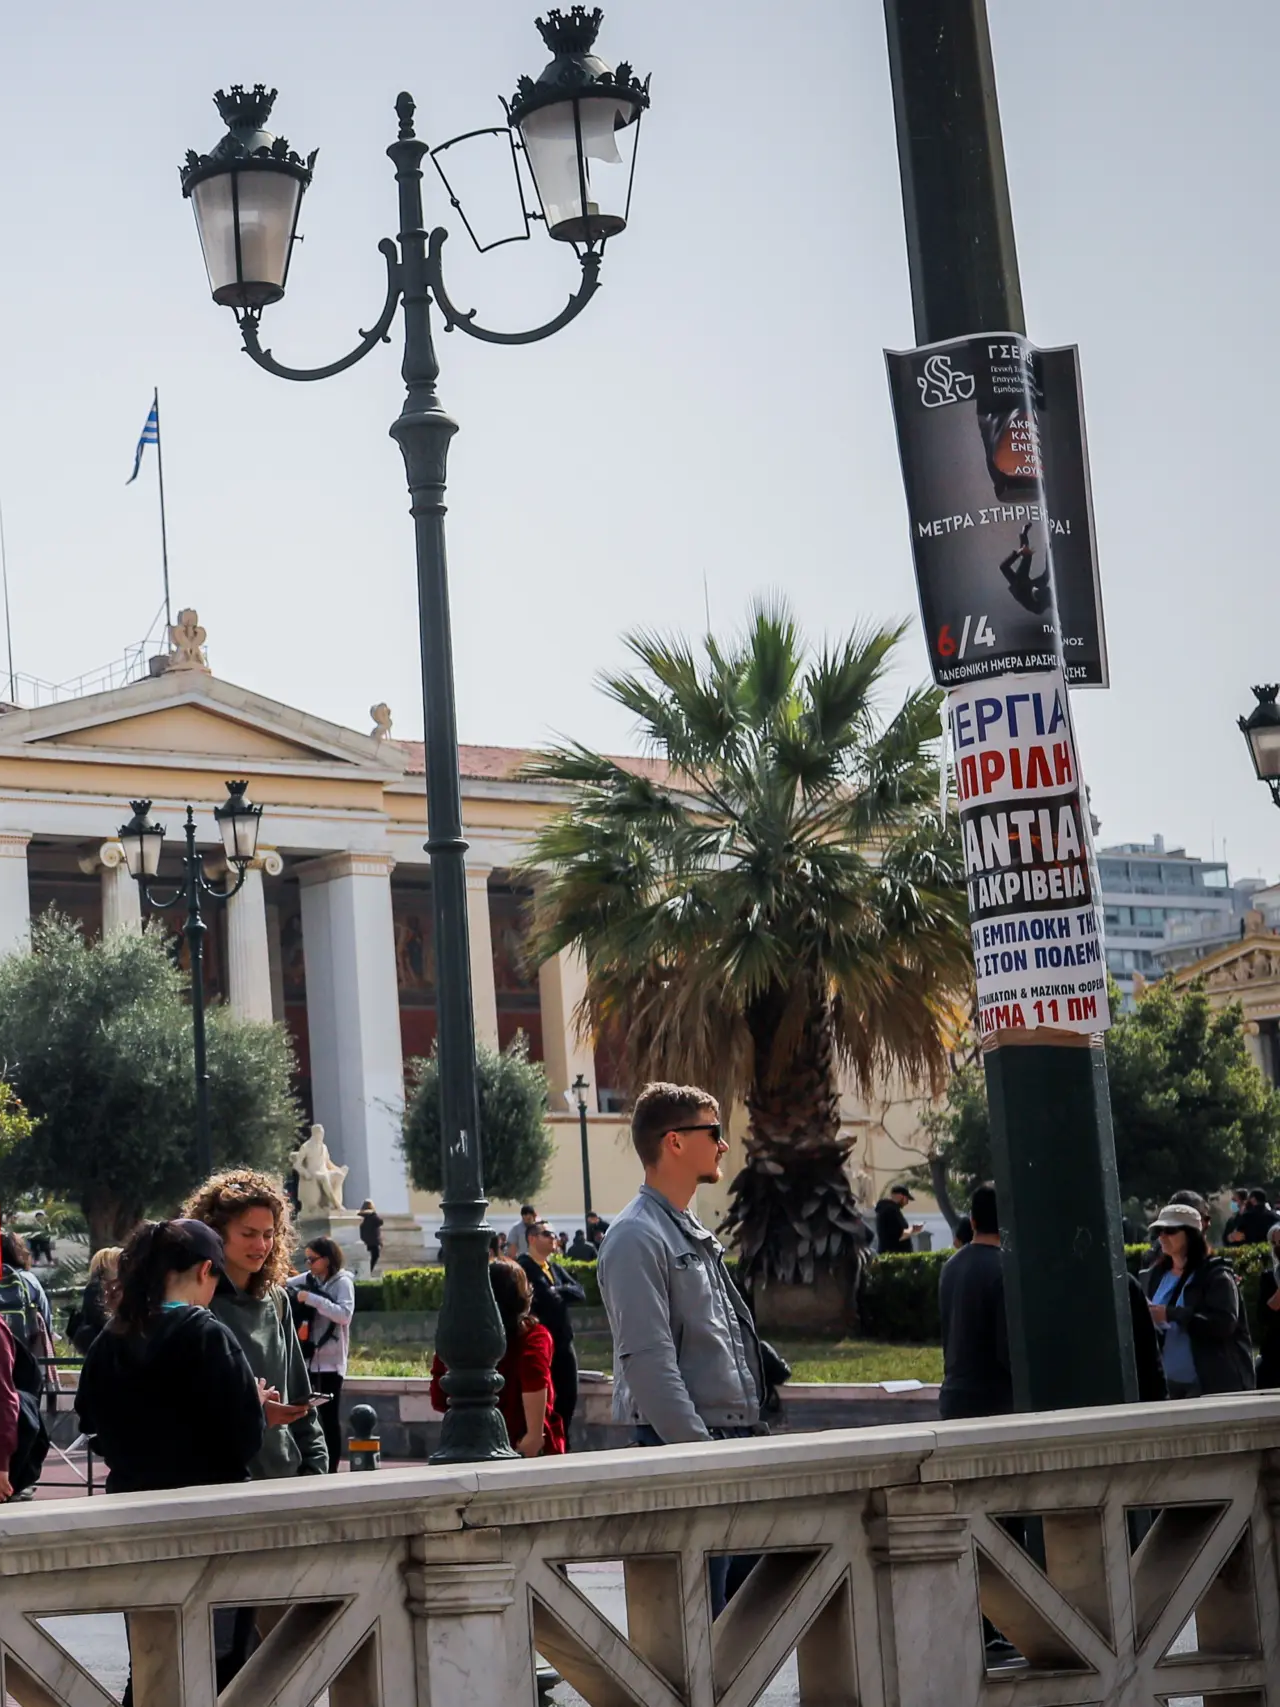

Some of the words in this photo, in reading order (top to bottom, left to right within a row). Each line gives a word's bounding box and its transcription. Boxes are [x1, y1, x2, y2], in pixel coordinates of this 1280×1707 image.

[918, 513, 974, 537] ΜΕΤΡΑ
[938, 615, 996, 659] 6/4
[990, 656, 1023, 672] ΗΜΕΡΑ
[979, 864, 1085, 909] ΑΚΡΙΒΕΙΑ
[983, 917, 1071, 948] ΕΜΠΛΟΚΗ
[985, 949, 1028, 976] ΣΤΟΝ
[1021, 988, 1027, 999] &
[1031, 984, 1075, 998] ΜΑΖΙΚΩΝ
[1033, 1000, 1059, 1023] 11
[1067, 995, 1097, 1021] ΠΜ
